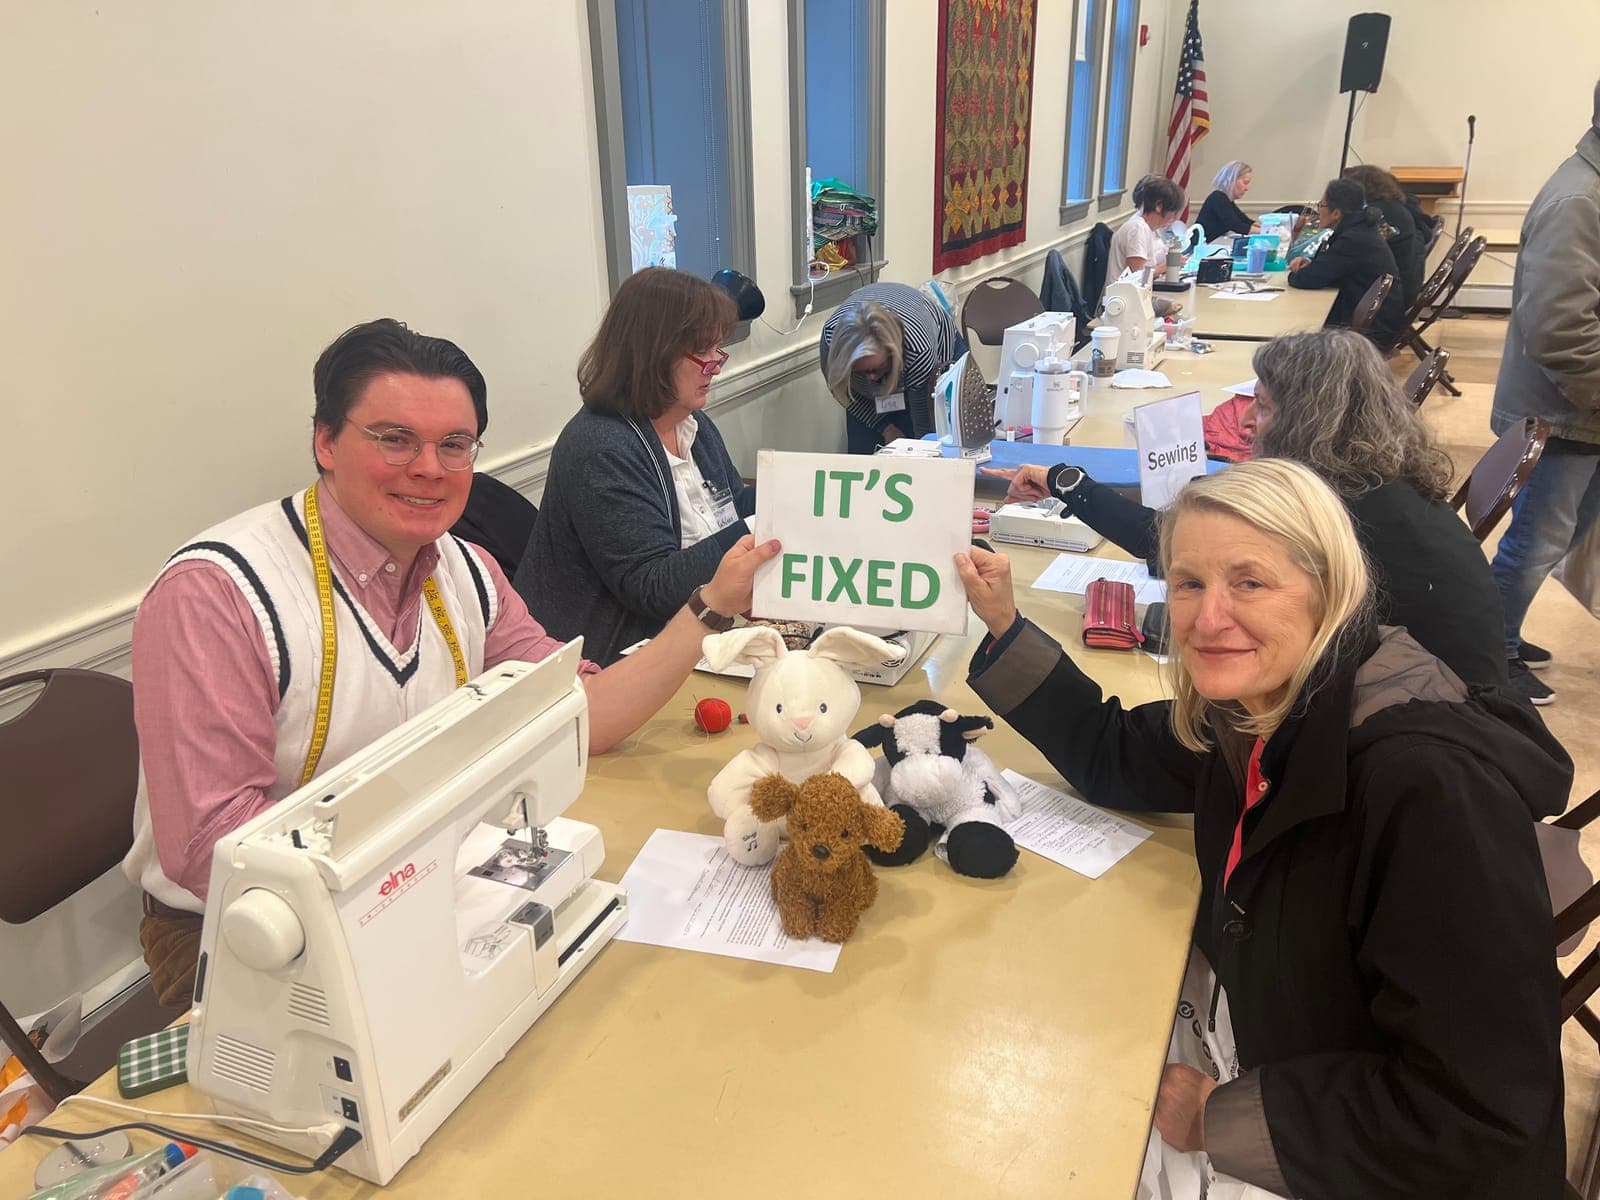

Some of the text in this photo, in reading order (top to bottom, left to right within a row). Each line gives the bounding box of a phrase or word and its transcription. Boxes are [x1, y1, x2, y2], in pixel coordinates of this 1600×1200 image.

[1148, 441, 1198, 471] Sewing
[813, 469, 914, 523] IT'S
[781, 553, 941, 610] FIXED
[378, 863, 416, 896] elna
